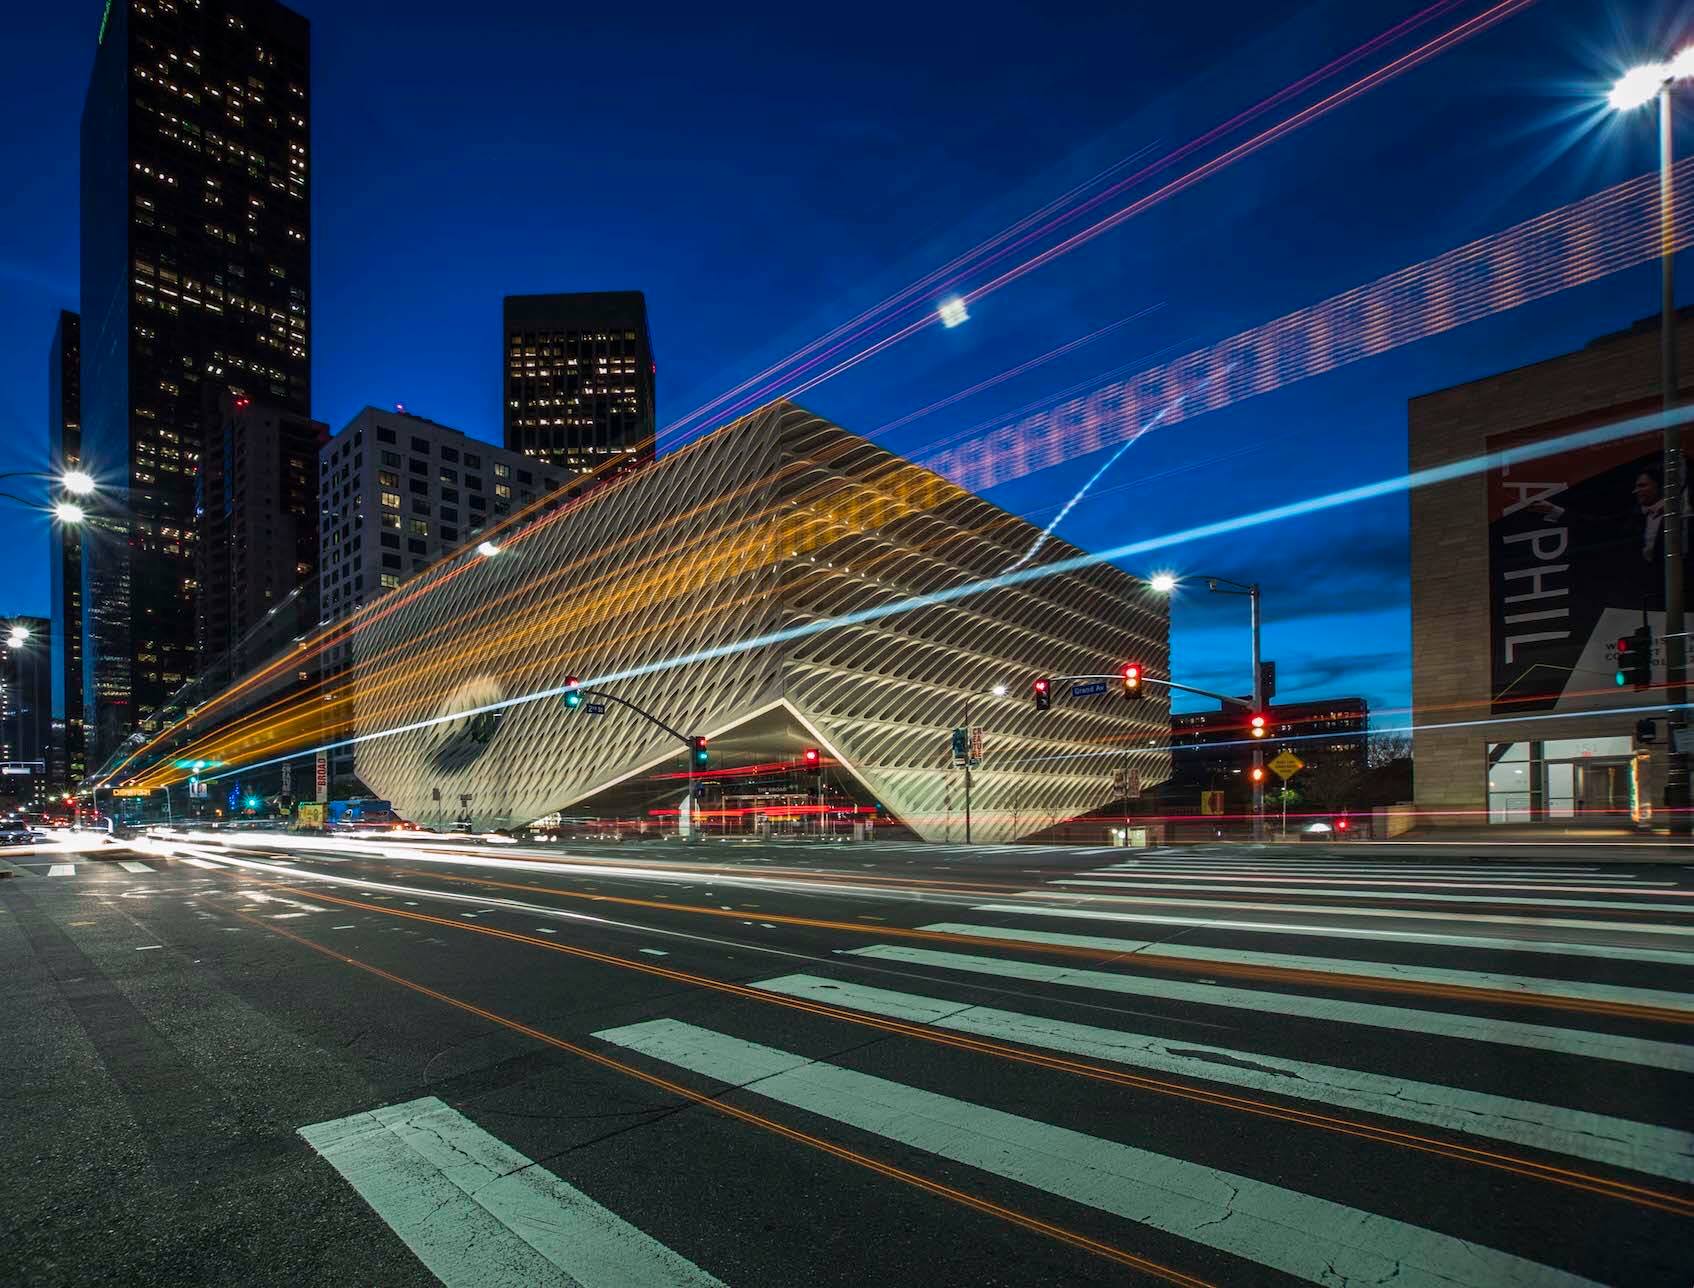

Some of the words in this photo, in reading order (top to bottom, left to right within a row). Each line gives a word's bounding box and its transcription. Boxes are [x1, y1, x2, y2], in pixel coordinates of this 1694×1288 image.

[1503, 527, 1571, 664] PHIL
[1074, 686, 1095, 695] Grand
[318, 758, 326, 785] BROAD
